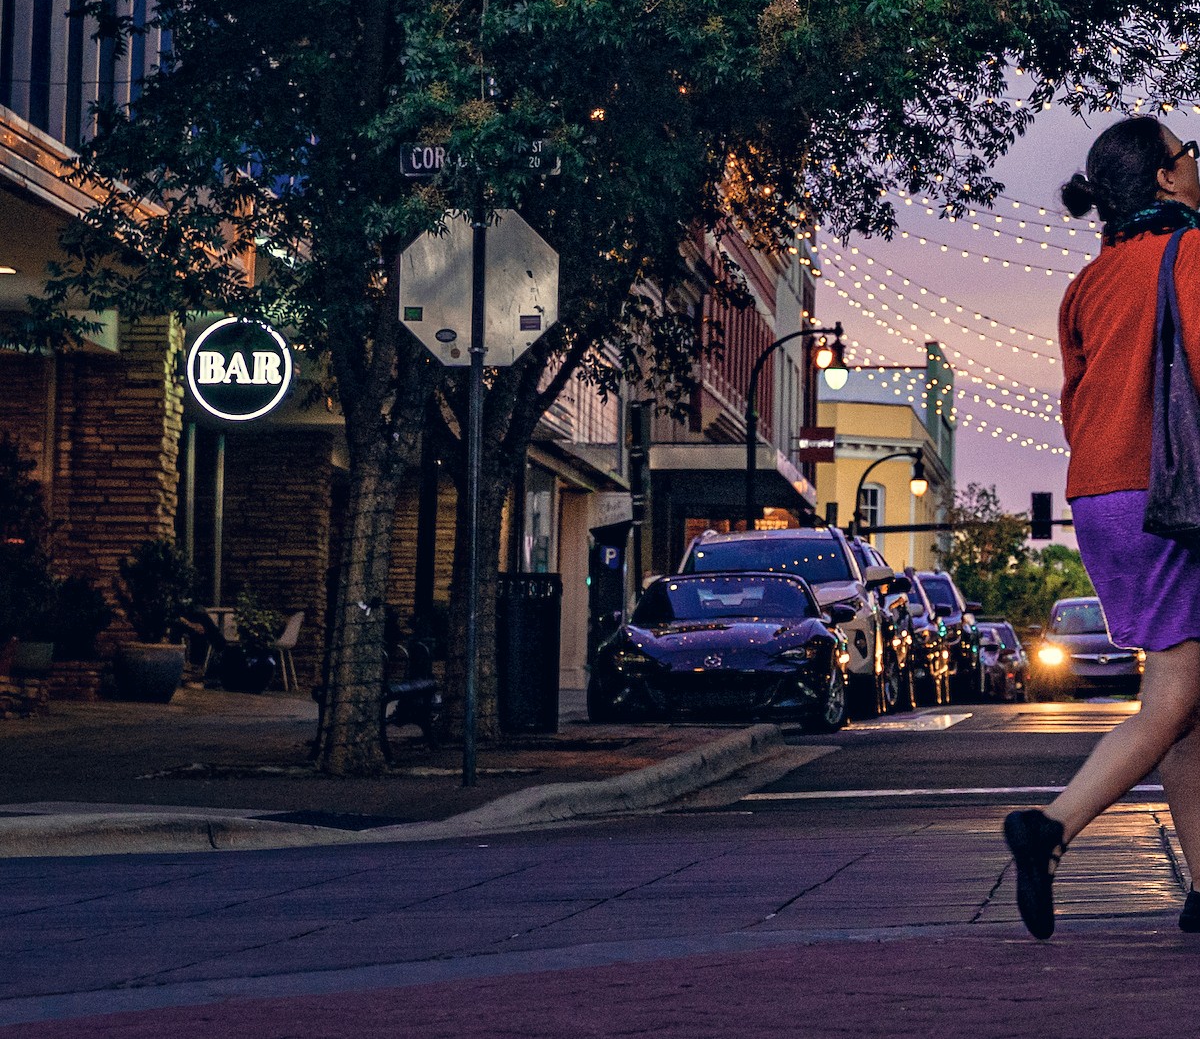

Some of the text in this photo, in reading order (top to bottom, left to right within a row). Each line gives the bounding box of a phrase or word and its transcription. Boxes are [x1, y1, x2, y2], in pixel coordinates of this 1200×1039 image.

[531, 140, 543, 153] ST
[197, 350, 283, 385] BAR
[604, 547, 617, 565] P
